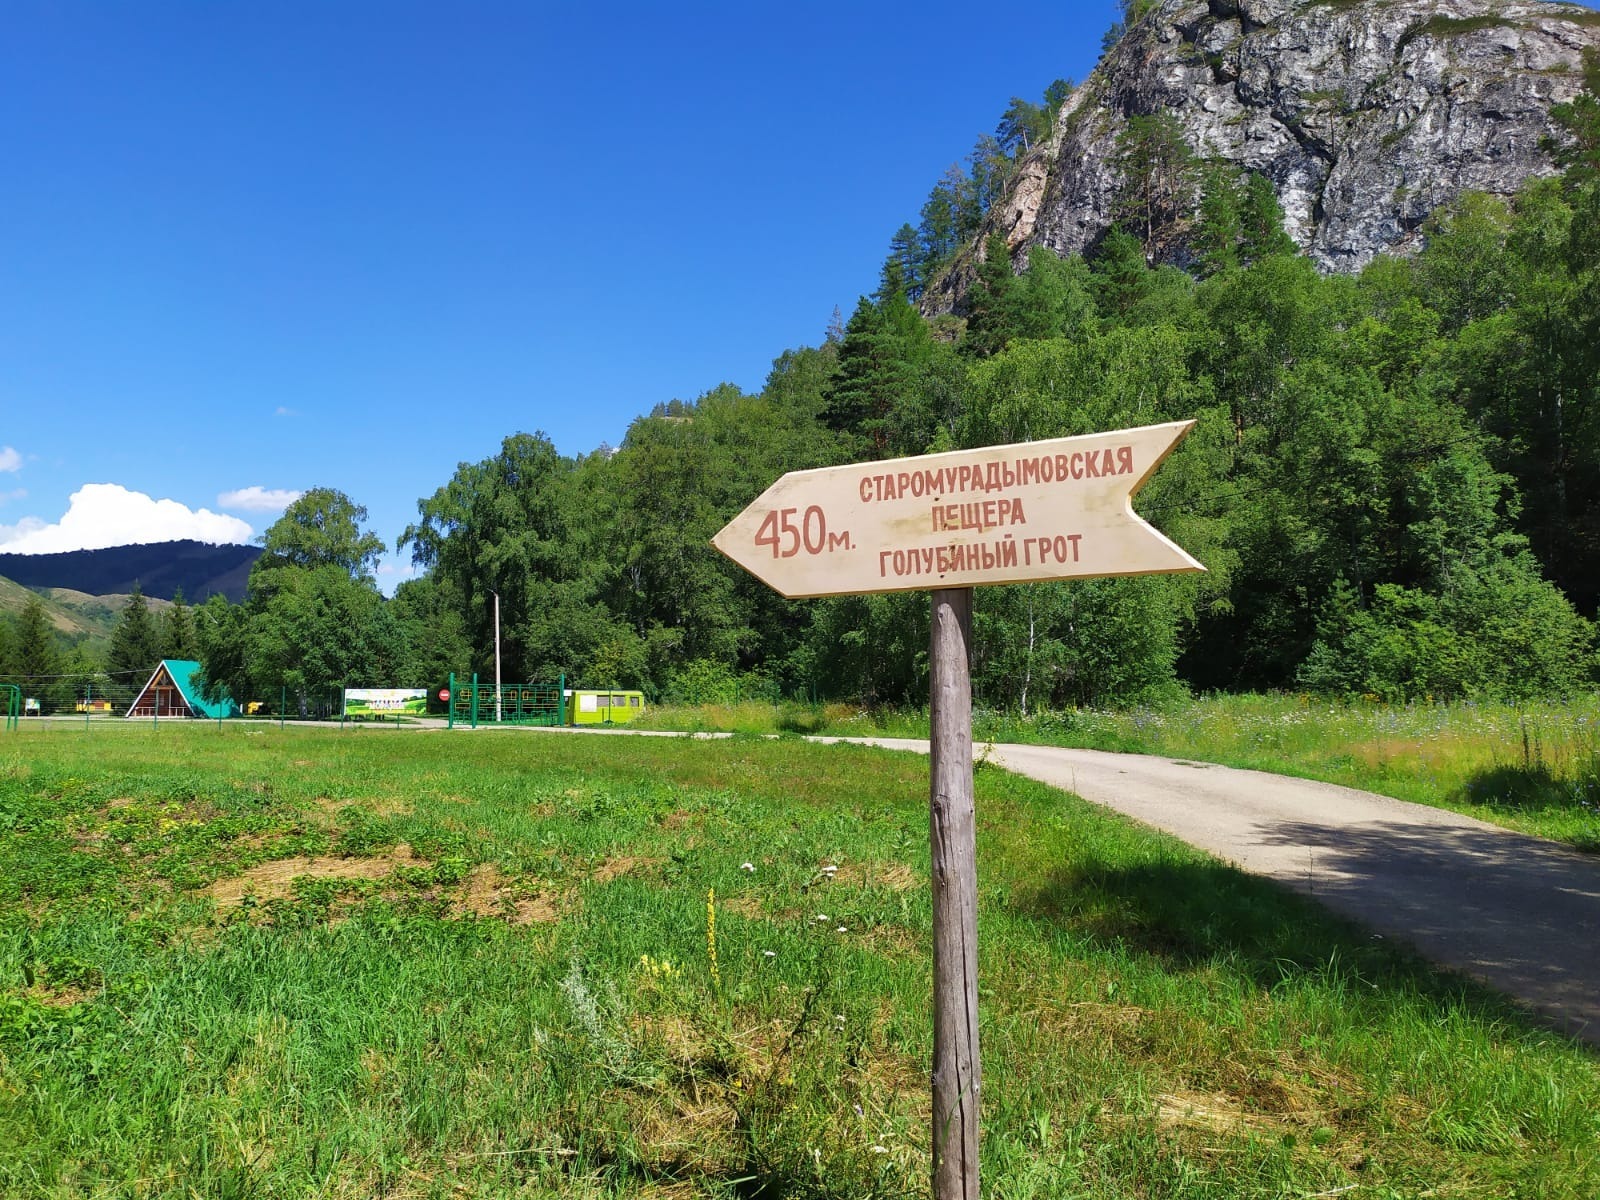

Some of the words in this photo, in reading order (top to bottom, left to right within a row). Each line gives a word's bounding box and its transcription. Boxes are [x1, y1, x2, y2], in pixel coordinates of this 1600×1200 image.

[859, 446, 1133, 503] СТАРОМУРАДЫМОВСКАЯ
[931, 498, 1026, 533] ПЕЩЕРА
[879, 534, 1018, 577] ГОЛУБИНЫЙ
[1023, 534, 1083, 566] ГРОТ
